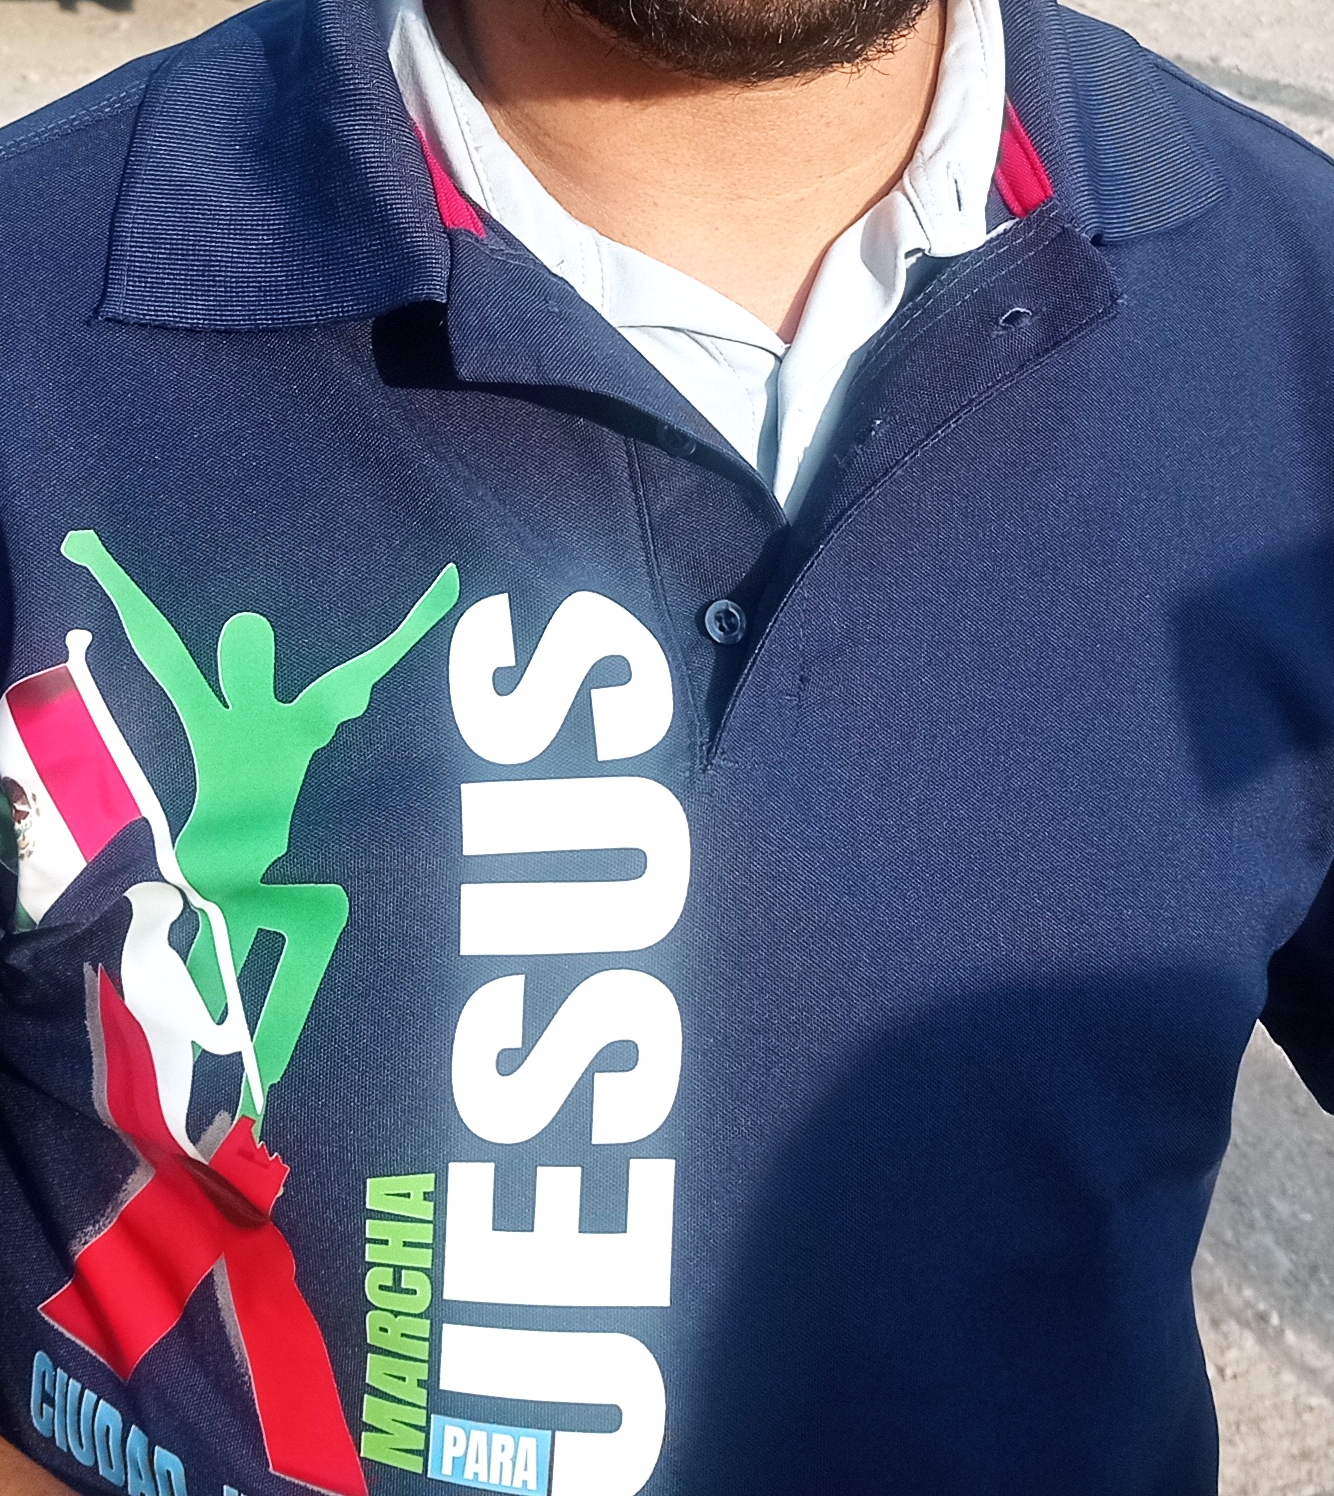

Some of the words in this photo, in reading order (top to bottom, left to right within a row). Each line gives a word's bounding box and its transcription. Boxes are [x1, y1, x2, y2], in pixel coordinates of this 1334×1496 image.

[439, 591, 691, 1496] JESUS
[31, 1351, 187, 1496] CIUDAD
[360, 1173, 436, 1474] MARCHA
[441, 1424, 538, 1490] PARA
